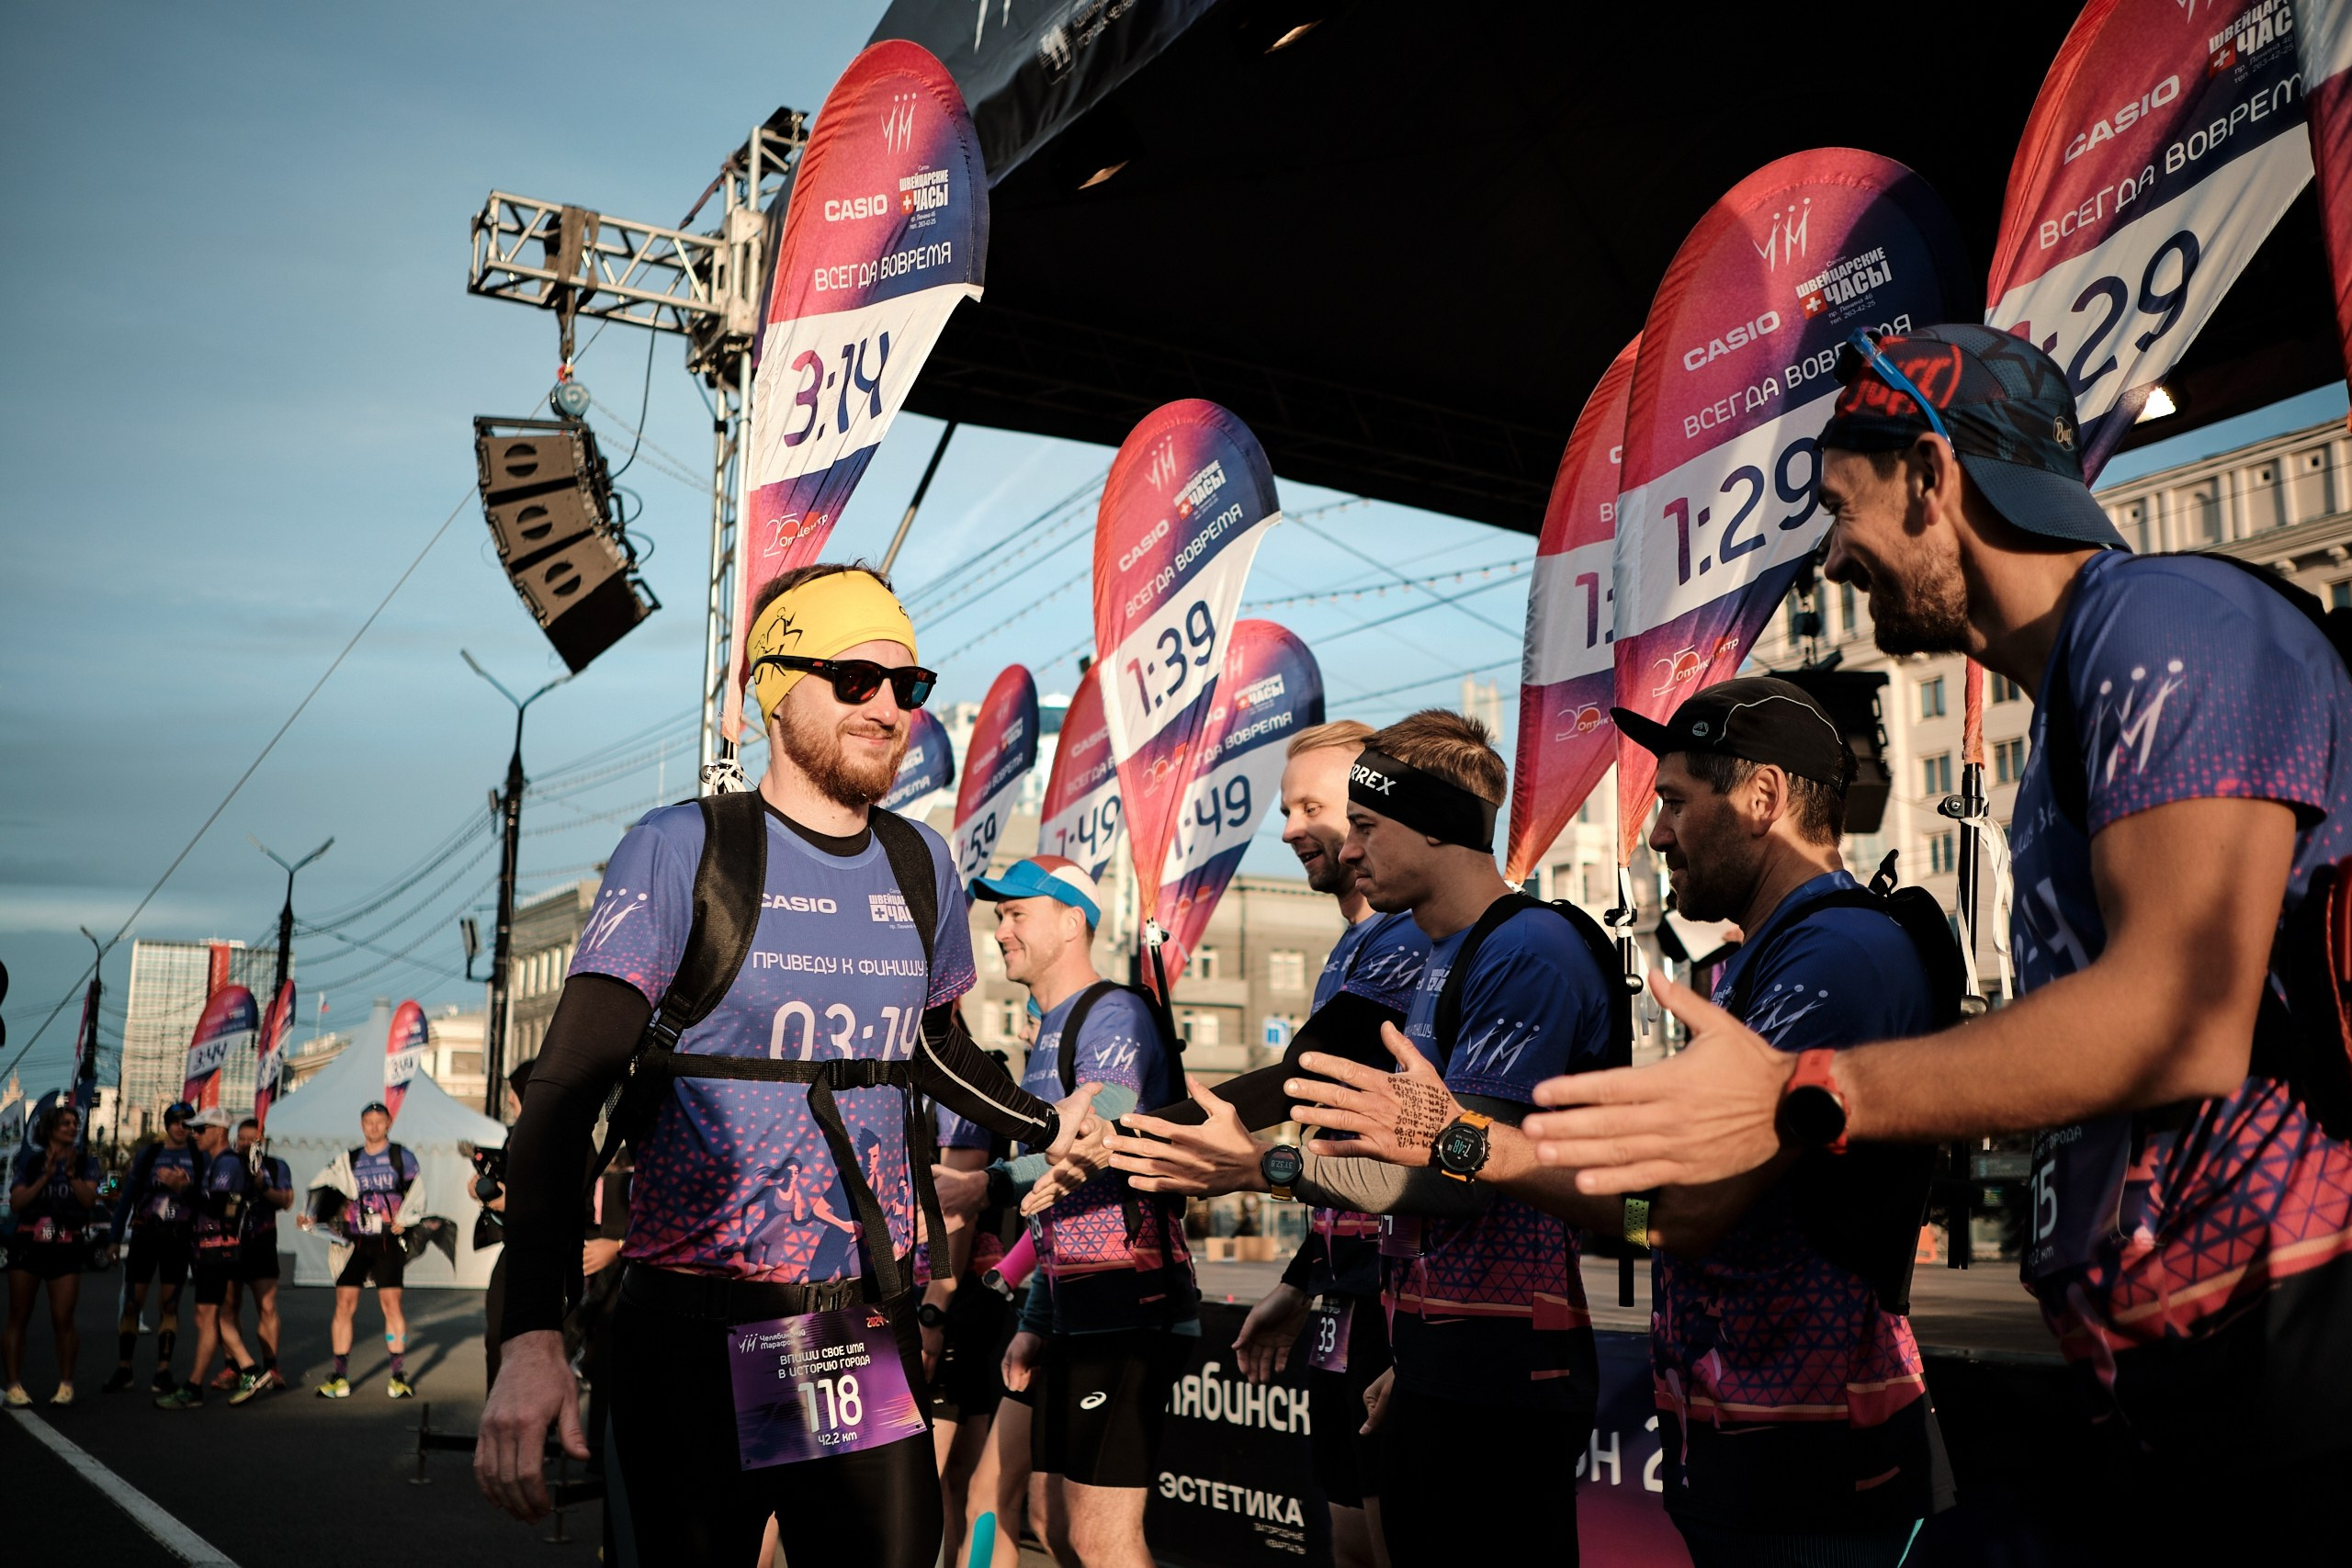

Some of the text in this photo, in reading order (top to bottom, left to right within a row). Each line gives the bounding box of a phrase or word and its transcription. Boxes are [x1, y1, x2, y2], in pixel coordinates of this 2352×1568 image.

[2236, 6, 2293, 56] ЧАС
[2064, 74, 2180, 165] CASIO
[899, 169, 949, 192] ШВЕЙЦАРСКИЕ
[2040, 73, 2303, 250] ВСЕГДА ВОВРЕМ
[824, 194, 888, 222] CASIO
[912, 184, 949, 212] ЧАСЫ
[815, 241, 952, 292] ВСЕГДА ВОВРЕМЯ
[1795, 246, 1886, 299] ШВЕЙЦАРСКИЕ
[1823, 260, 1893, 306] ЧАСЫ
[1839, 299, 1864, 313] Ленина
[1843, 299, 1876, 319] 263-42-25
[1683, 310, 1781, 372] CASIO
[784, 331, 889, 447] 3:14
[1683, 377, 1781, 439] ВСЕГДА
[1188, 468, 1227, 506] ЧАСЫ
[1663, 436, 1824, 586] 1:29
[1118, 519, 1170, 572] CASIO
[1125, 565, 1176, 620] ВСЕГДА
[1175, 502, 1244, 571] ВОВРЕМЯ
[1125, 600, 1216, 717] 1:39
[1249, 682, 1284, 705] ЧАСЫ
[1225, 711, 1293, 750] ВОВРЕМЯ
[1351, 763, 1396, 795] RREX
[761, 893, 838, 914] CASIO
[868, 892, 906, 906] ШВЕЙЦА
[887, 905, 914, 922] ЧАС
[752, 952, 924, 976] ПРИВЕДУ К ФИНИШУ
[1453, 1139, 1472, 1157] 7:48
[759, 1328, 807, 1342] Челябинский
[760, 1339, 796, 1350] Марафон
[779, 1342, 865, 1366] ВПИШИ СВОЕ ИМЯ
[778, 1354, 871, 1379] В ИСТОРИЮ ГОРОДА
[797, 1374, 863, 1433] 118
[1165, 1361, 1311, 1435] ябинск
[818, 1432, 840, 1446] 42,2
[1159, 1472, 1305, 1527] ЭСТЕТИКА
